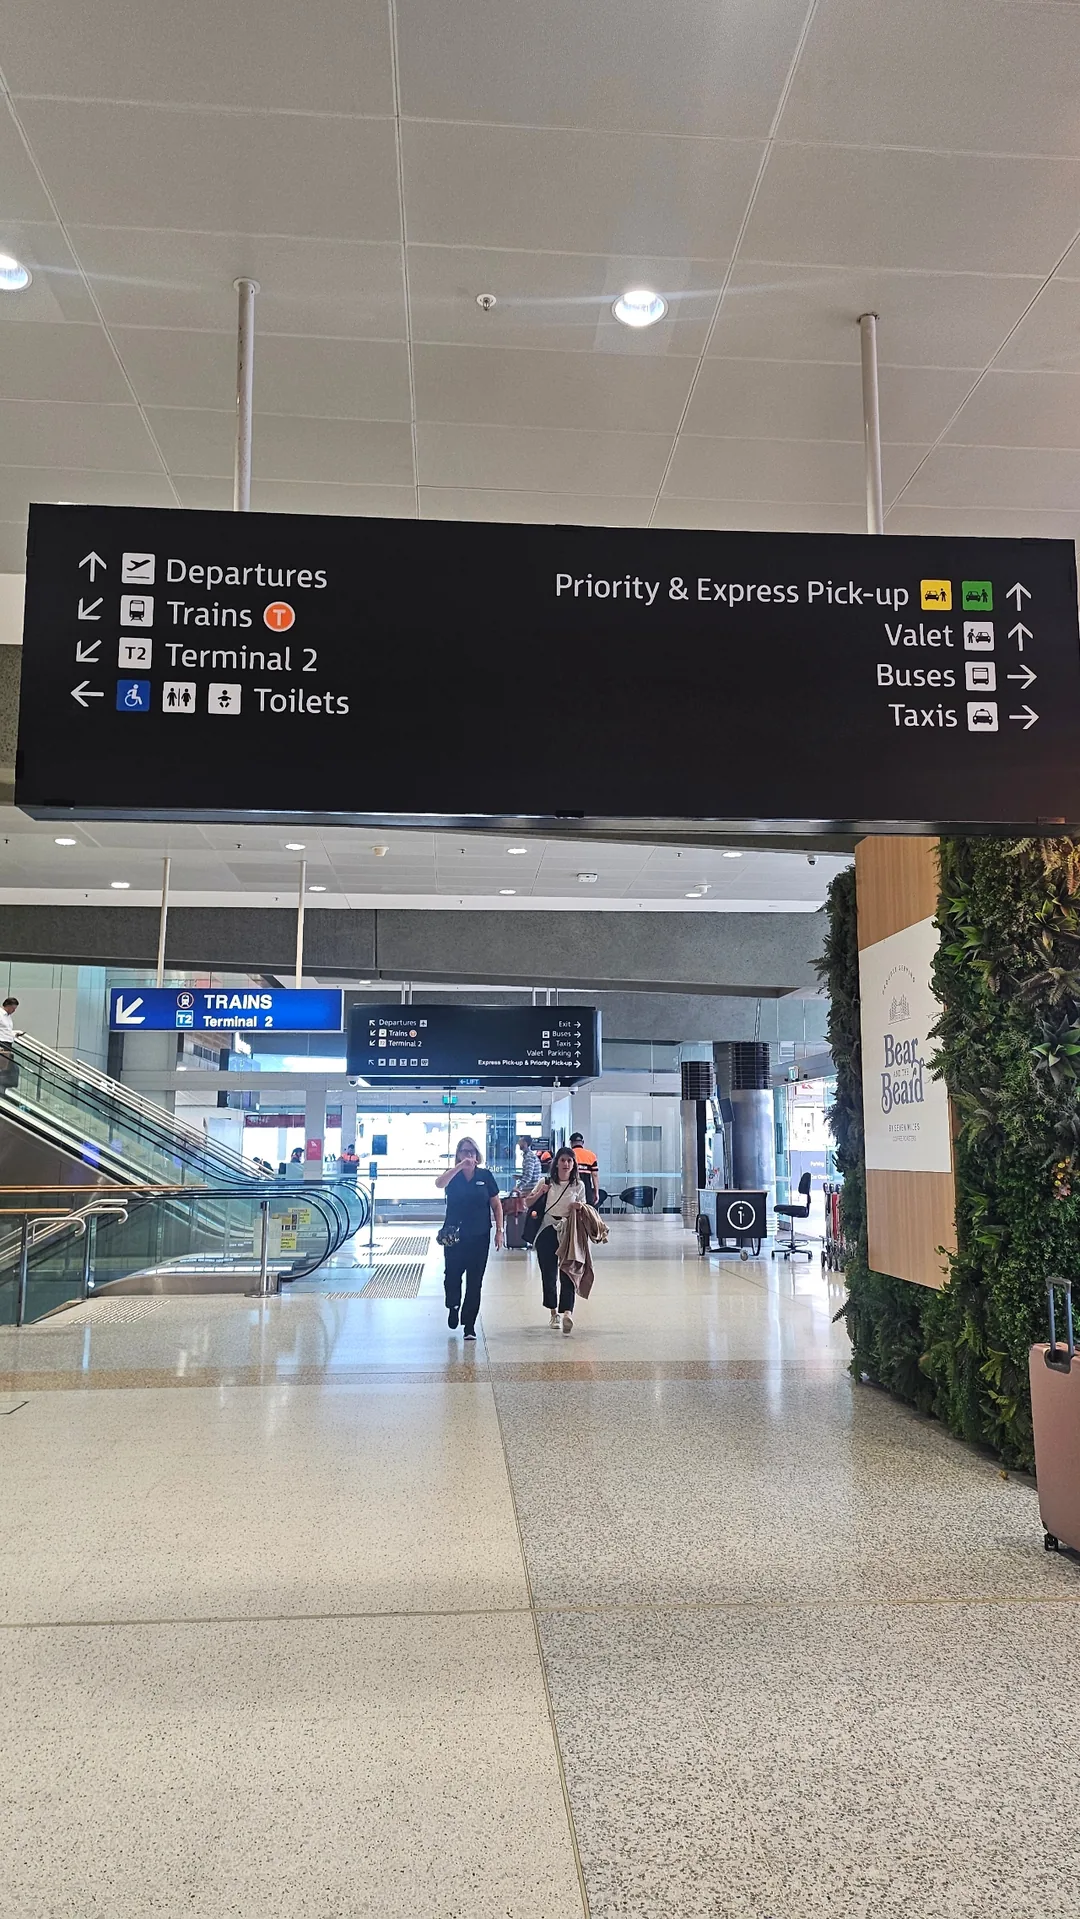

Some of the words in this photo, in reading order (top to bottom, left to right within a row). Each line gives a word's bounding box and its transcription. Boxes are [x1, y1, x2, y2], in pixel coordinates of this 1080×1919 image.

[167, 558, 328, 590] Departures
[555, 573, 659, 606] Priority
[668, 576, 690, 601] &
[697, 577, 799, 608] Express
[808, 580, 910, 611] Pick-up
[167, 600, 252, 628] Trains
[273, 608, 287, 626] T
[885, 622, 954, 648] Valet
[125, 646, 147, 661] T2
[165, 643, 292, 671] Terminal
[302, 648, 318, 672] 2
[877, 663, 956, 688] Buses
[254, 687, 350, 715] Toilets
[889, 703, 958, 728] Taxis
[204, 994, 273, 1010] TRAINS
[177, 1013, 193, 1025] T2
[203, 1015, 258, 1028] Terminal
[264, 1016, 273, 1028] 2
[379, 1019, 417, 1027] Departures
[558, 1020, 571, 1028] Exit
[552, 1030, 572, 1038] Buses
[547, 1049, 572, 1058] Parking
[884, 1034, 919, 1068] Bear
[502, 1059, 524, 1067] Pick-up
[530, 1059, 550, 1068] Priority
[466, 1078, 480, 1086] LIFT
[881, 1058, 924, 1114] Beard
